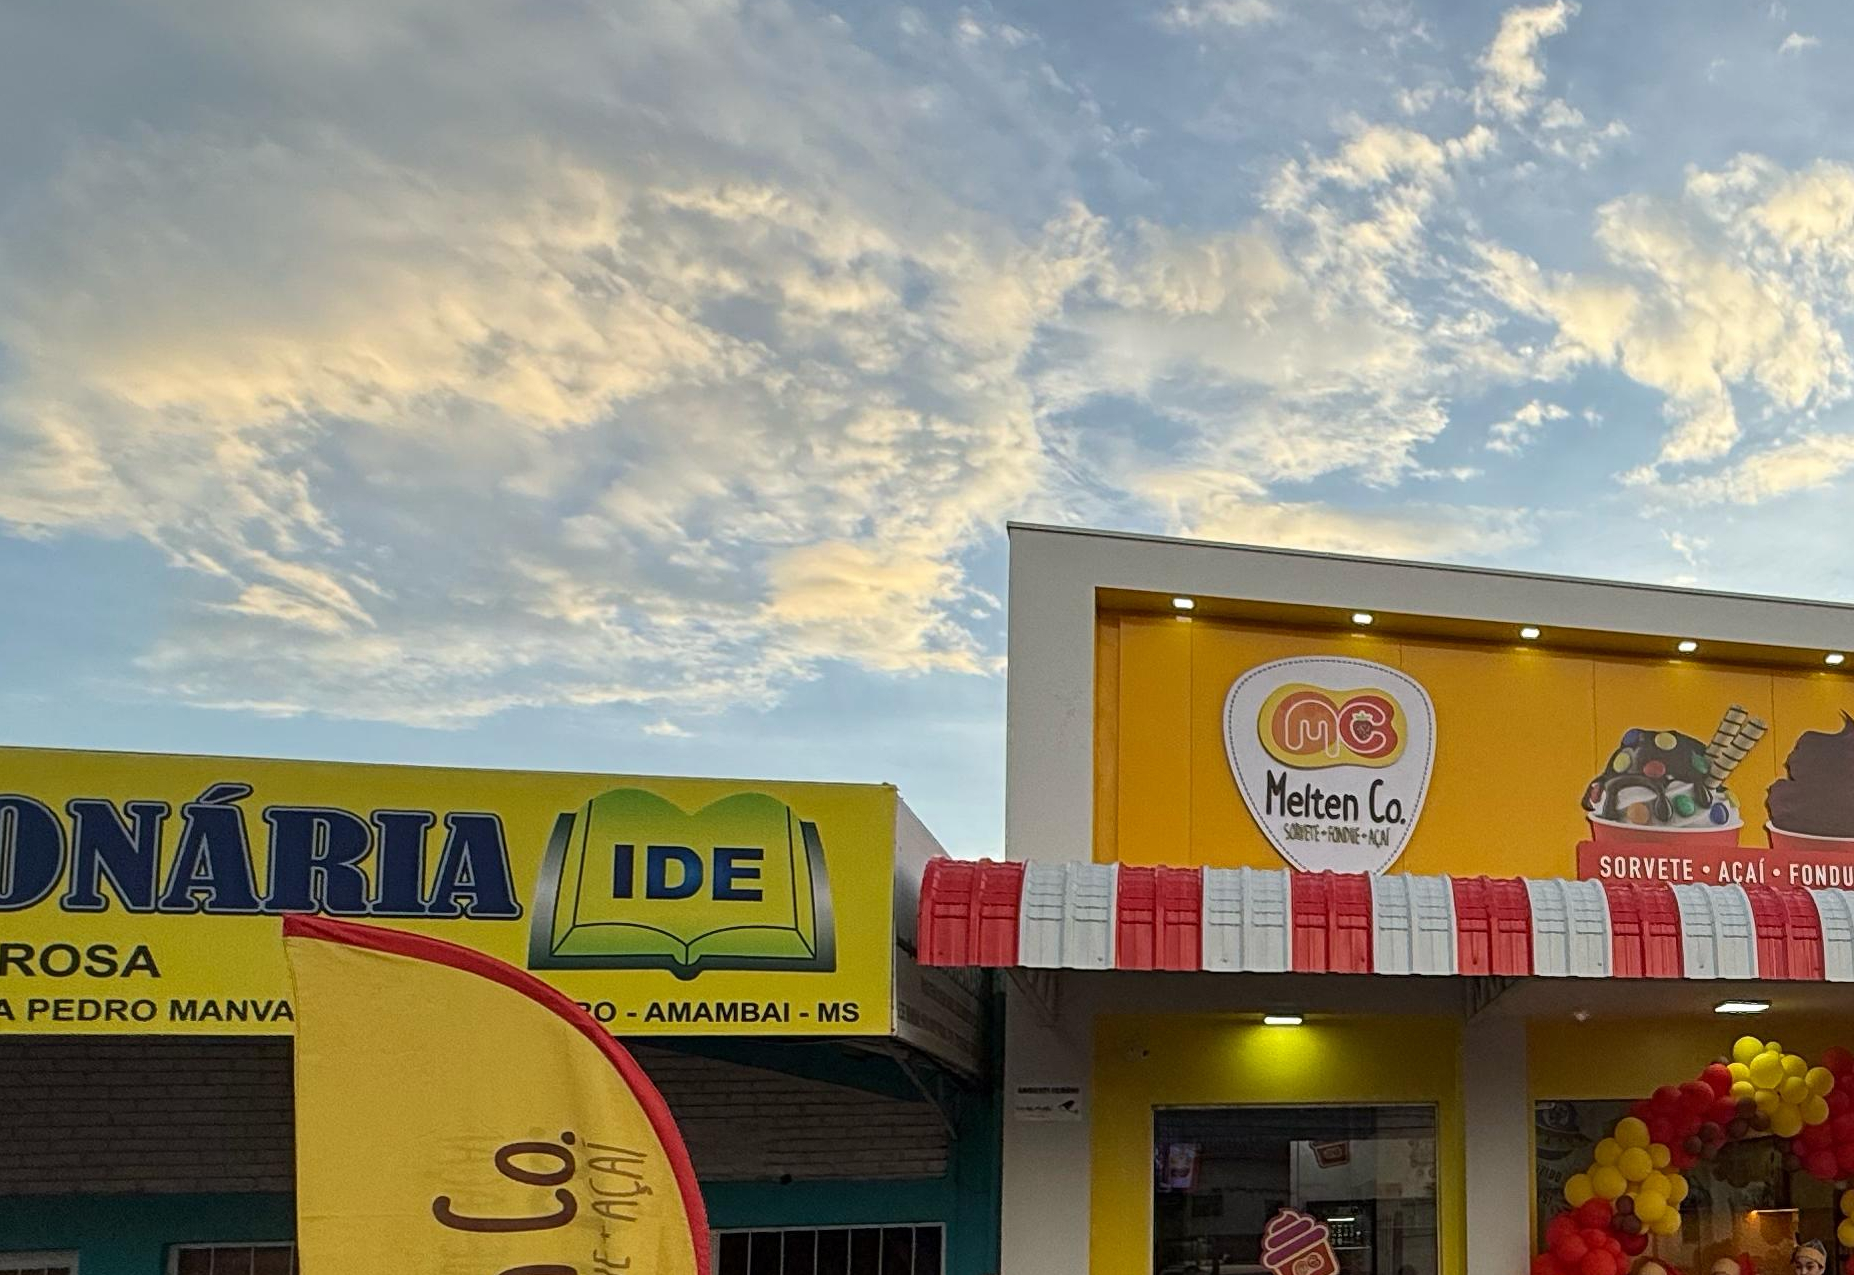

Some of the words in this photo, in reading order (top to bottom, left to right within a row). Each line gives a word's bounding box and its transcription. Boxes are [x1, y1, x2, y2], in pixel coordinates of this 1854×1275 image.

[1266, 770, 1359, 822] Melten
[1369, 779, 1406, 825] Co.
[1284, 823, 1320, 843] SORVETE
[1328, 825, 1360, 845] FONDUE
[613, 844, 764, 902] IDE
[1600, 856, 1693, 881] SORVETE
[1718, 857, 1765, 884] AÇAÍ
[0, 943, 160, 977] ROSA
[28, 999, 158, 1022] PEDRO
[170, 999, 295, 1022] MANVA
[644, 1002, 789, 1023] AMAMBAI
[818, 1002, 860, 1023] MS
[432, 1130, 577, 1234] Co.
